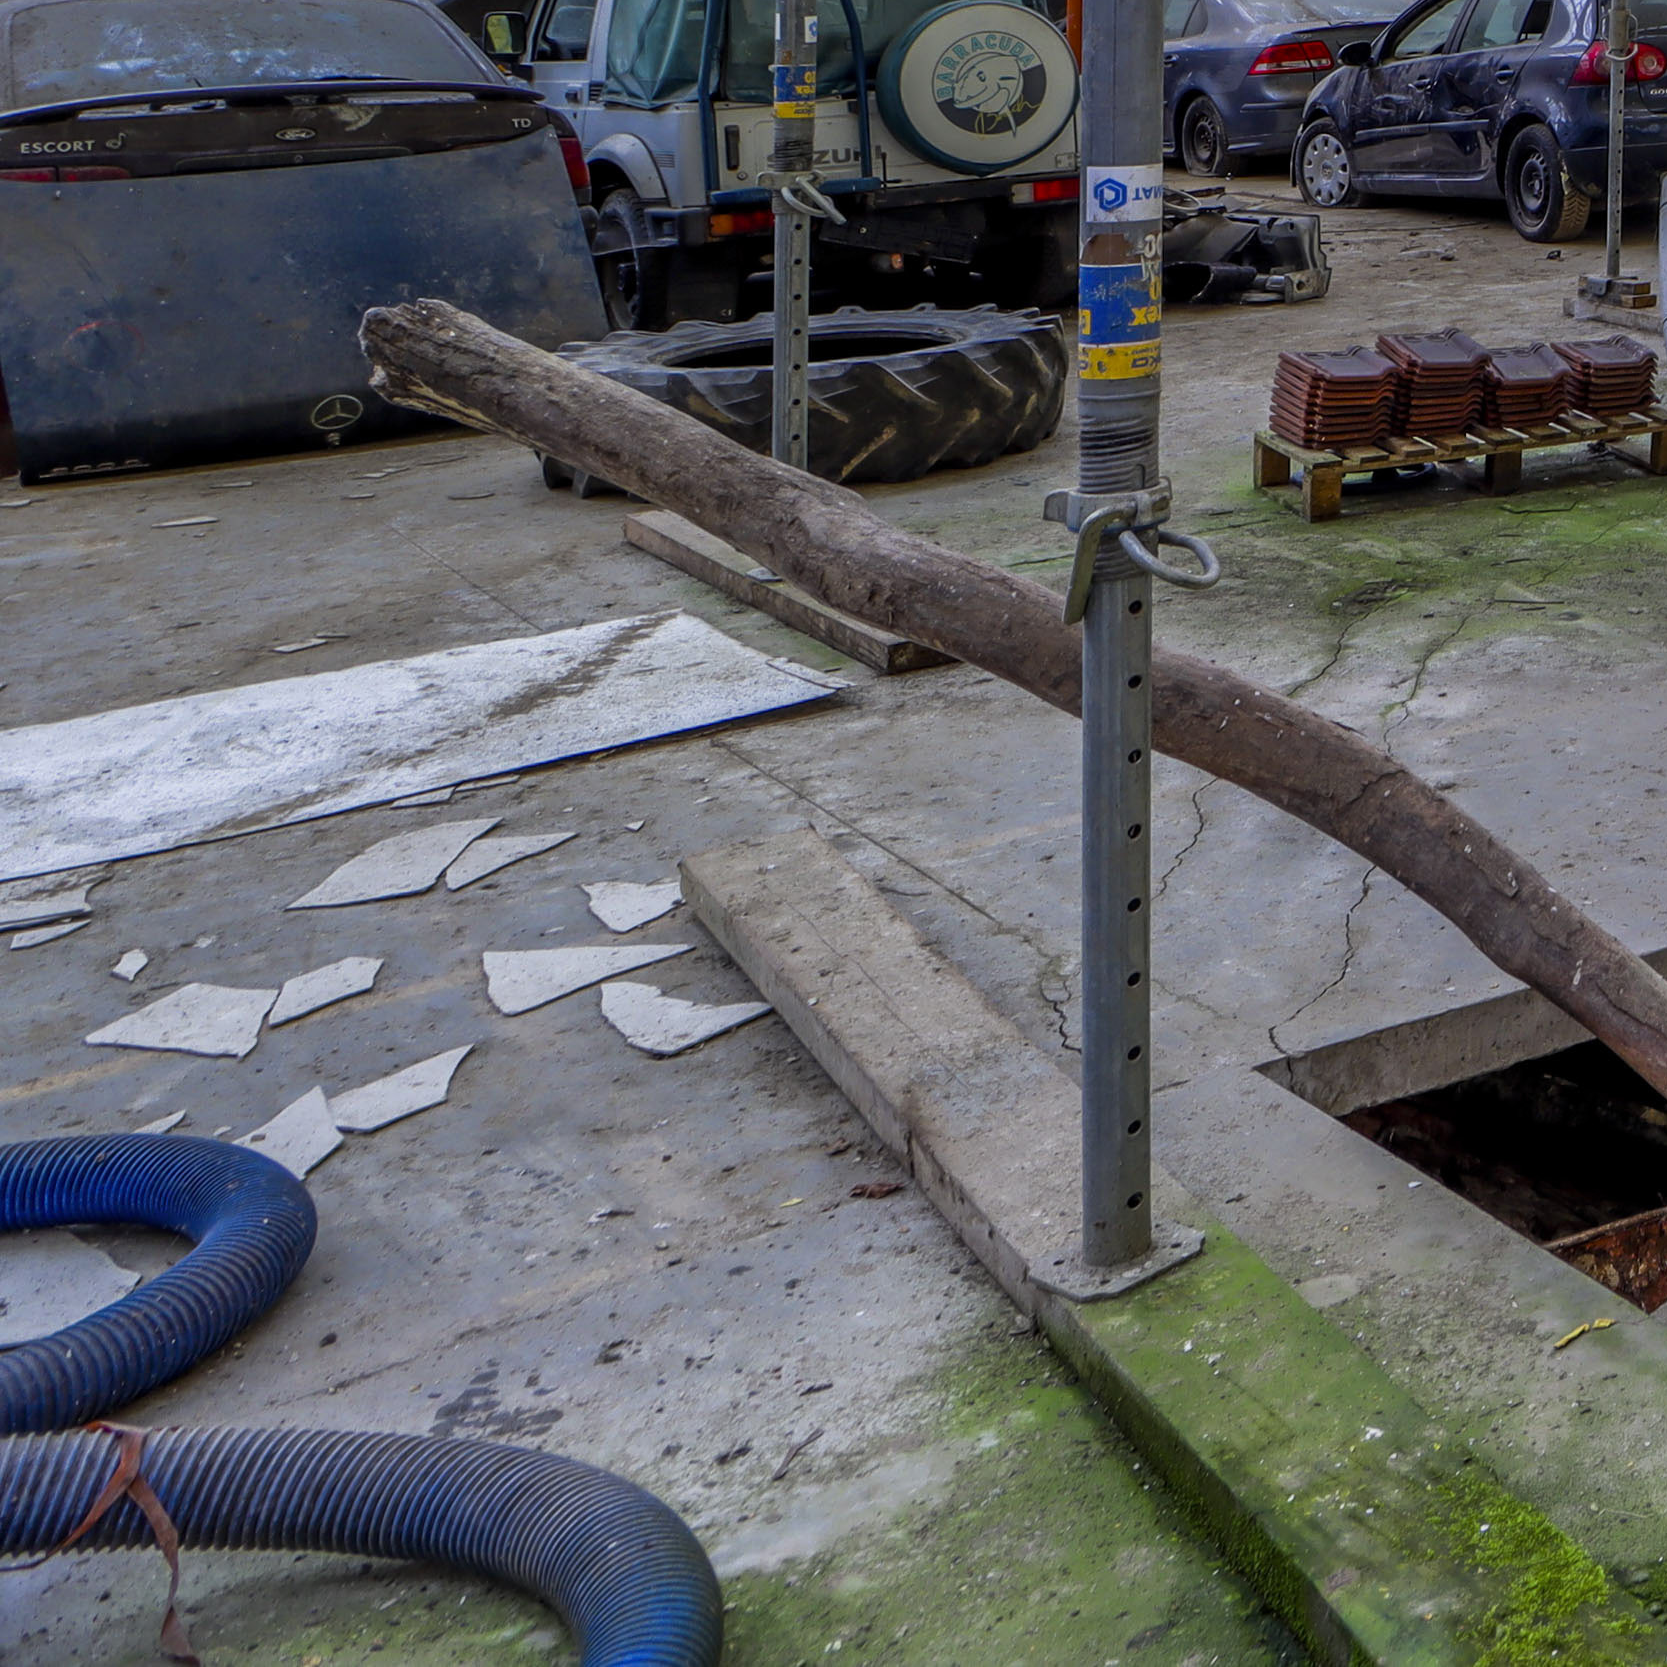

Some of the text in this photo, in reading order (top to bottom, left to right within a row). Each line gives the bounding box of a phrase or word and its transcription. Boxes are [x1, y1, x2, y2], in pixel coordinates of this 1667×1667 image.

[936, 34, 1036, 99] BARRACUDA
[511, 117, 532, 128] TD
[20, 140, 96, 154] ESCORT
